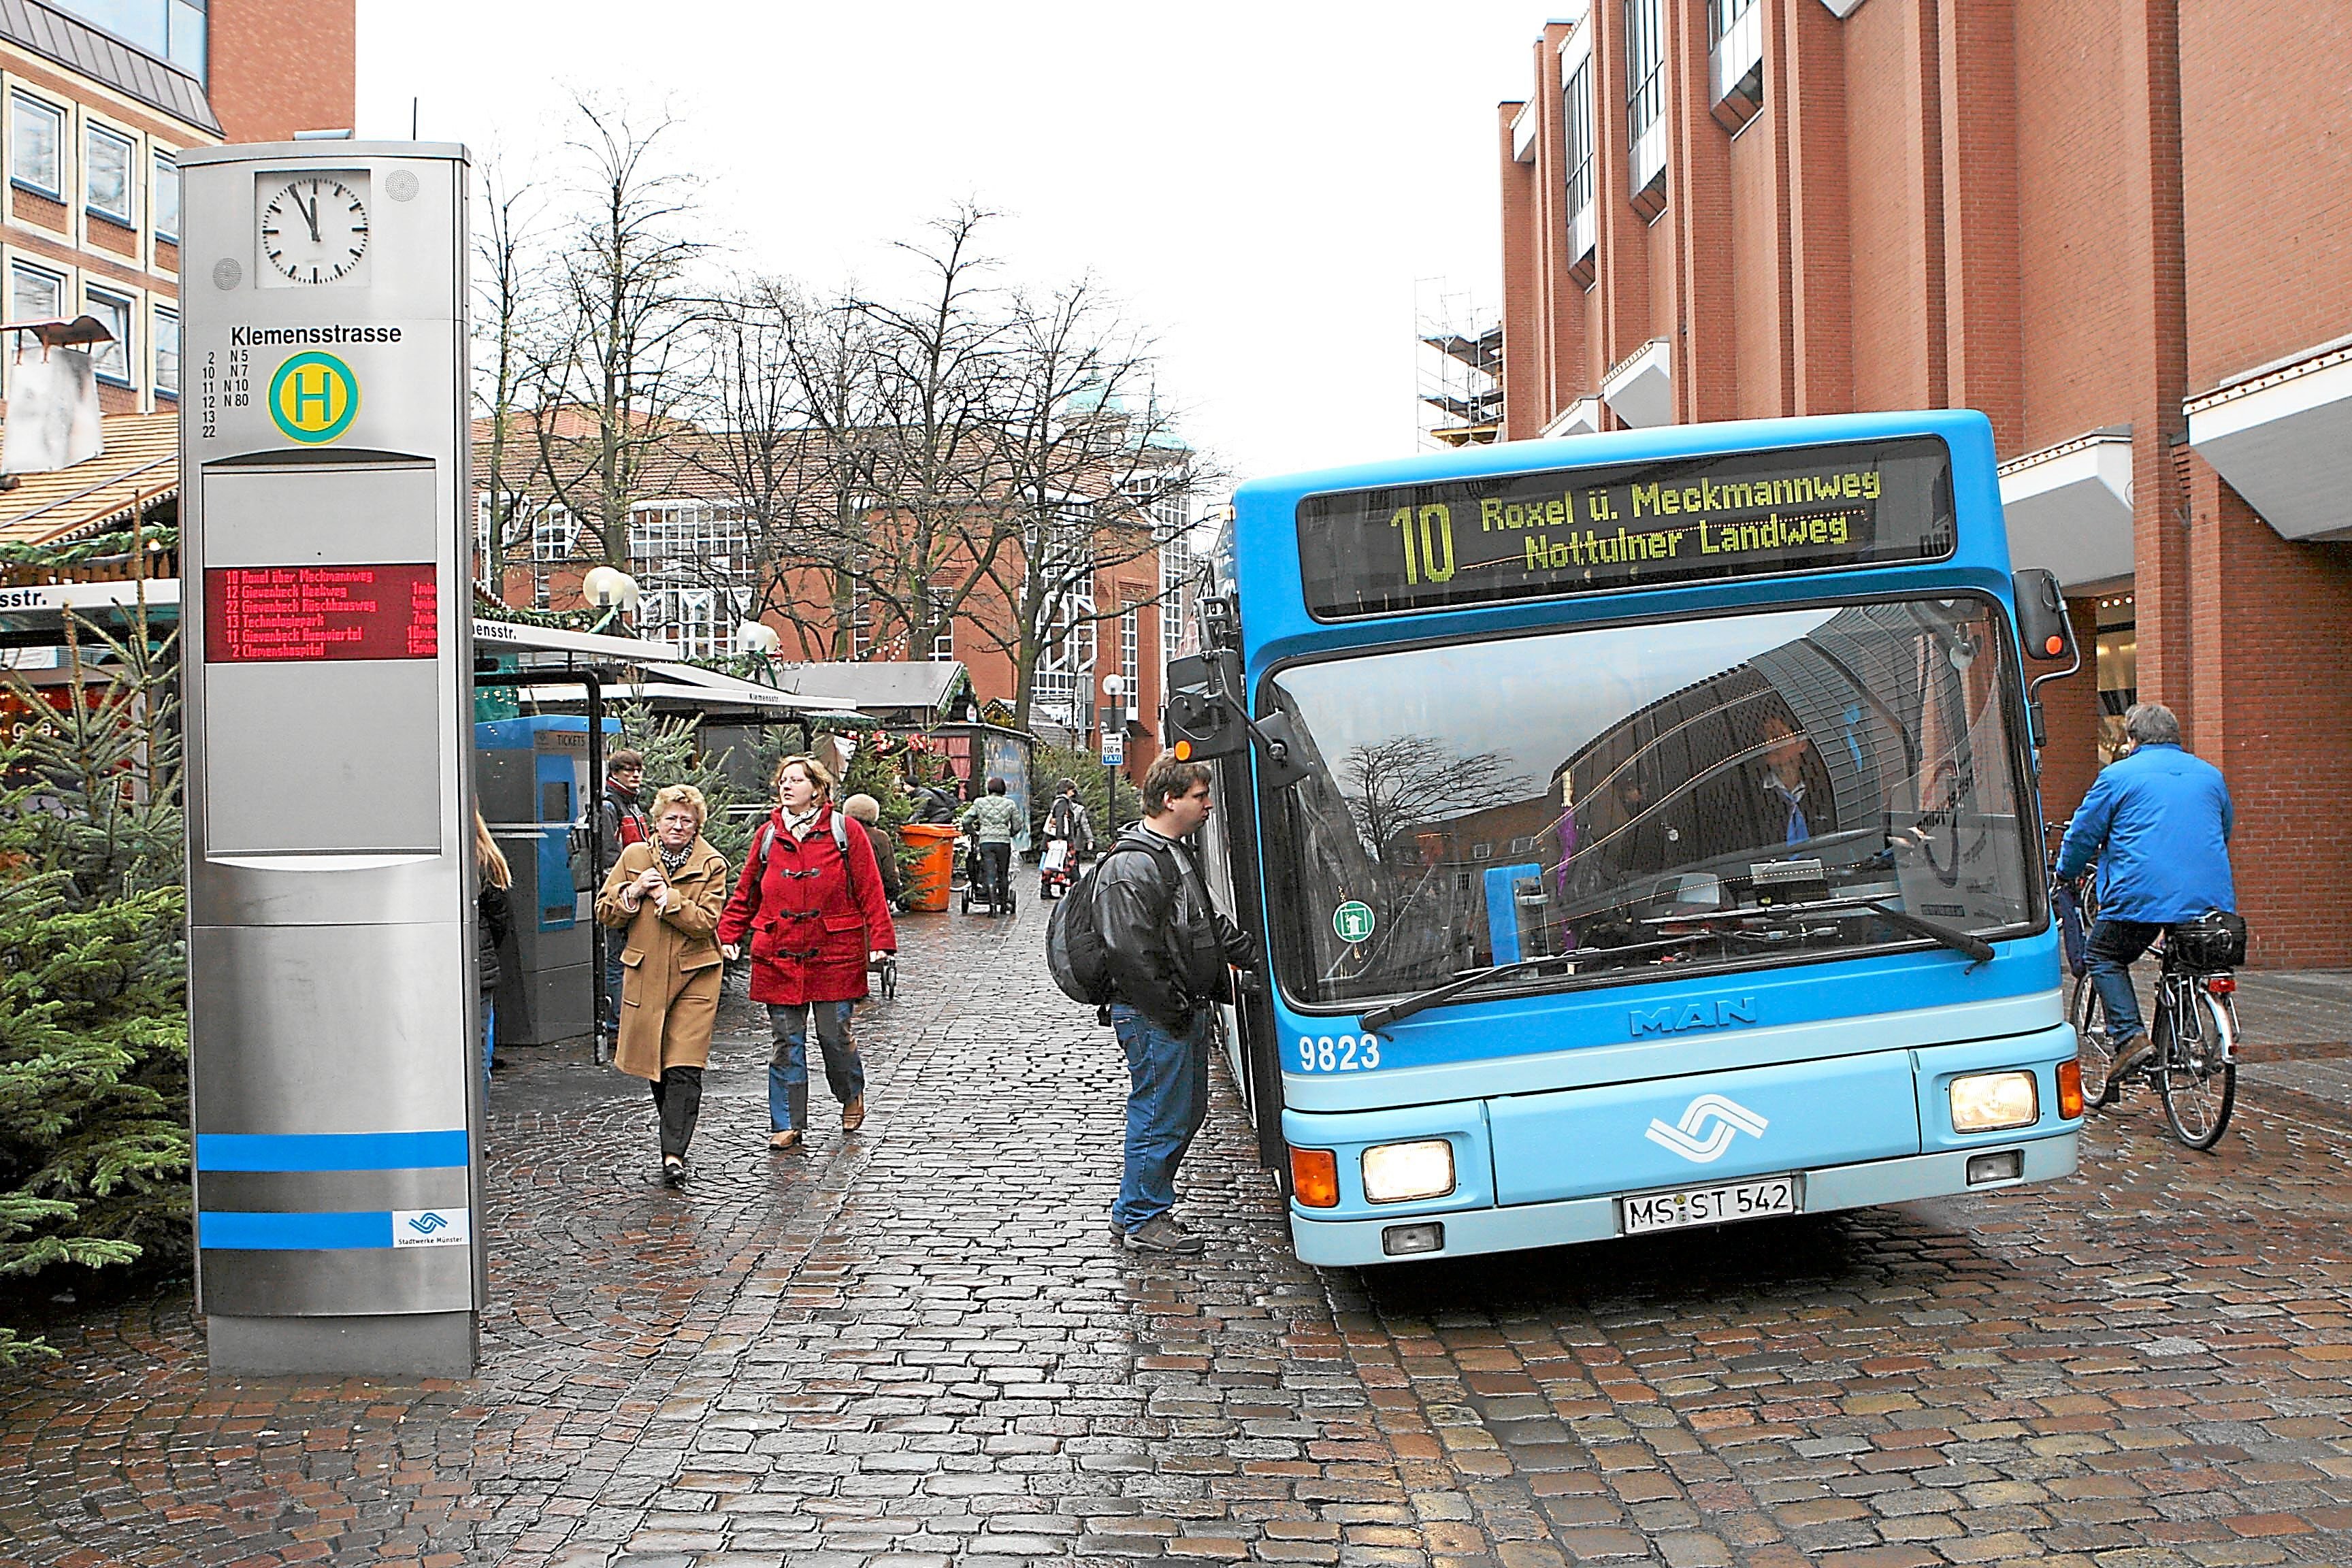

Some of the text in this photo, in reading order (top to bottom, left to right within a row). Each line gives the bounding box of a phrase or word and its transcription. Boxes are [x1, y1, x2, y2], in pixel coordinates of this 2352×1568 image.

[231, 325, 402, 346] Klemensstrasse
[208, 352, 214, 364] 2
[230, 350, 248, 362] N 5
[203, 367, 215, 378] 10
[230, 365, 248, 376] N 7
[203, 382, 214, 393] 11
[224, 379, 248, 392] N 10
[203, 396, 215, 408] 12
[224, 394, 248, 406] N 80
[296, 372, 331, 422] H
[203, 411, 215, 423] 13
[203, 425, 215, 438] 22
[1481, 471, 1881, 532] Roxel ü. Meckmannweg
[1390, 504, 1455, 585] 10
[1524, 512, 1850, 571] Nottulner Landweg
[226, 570, 238, 583] 10
[299, 569, 374, 583] Meckmannweg
[226, 585, 239, 599] 12
[226, 600, 239, 613] 22
[226, 614, 325, 629] 13 Technologiepark
[226, 630, 238, 643] 11
[473, 623, 517, 640] ensstr.
[232, 642, 325, 658] 2 Clemenshospital
[556, 734, 585, 747] TICKETS
[1629, 997, 1757, 1036] MAN
[1299, 1033, 1380, 1071] 9823
[1737, 1184, 1788, 1213] 542
